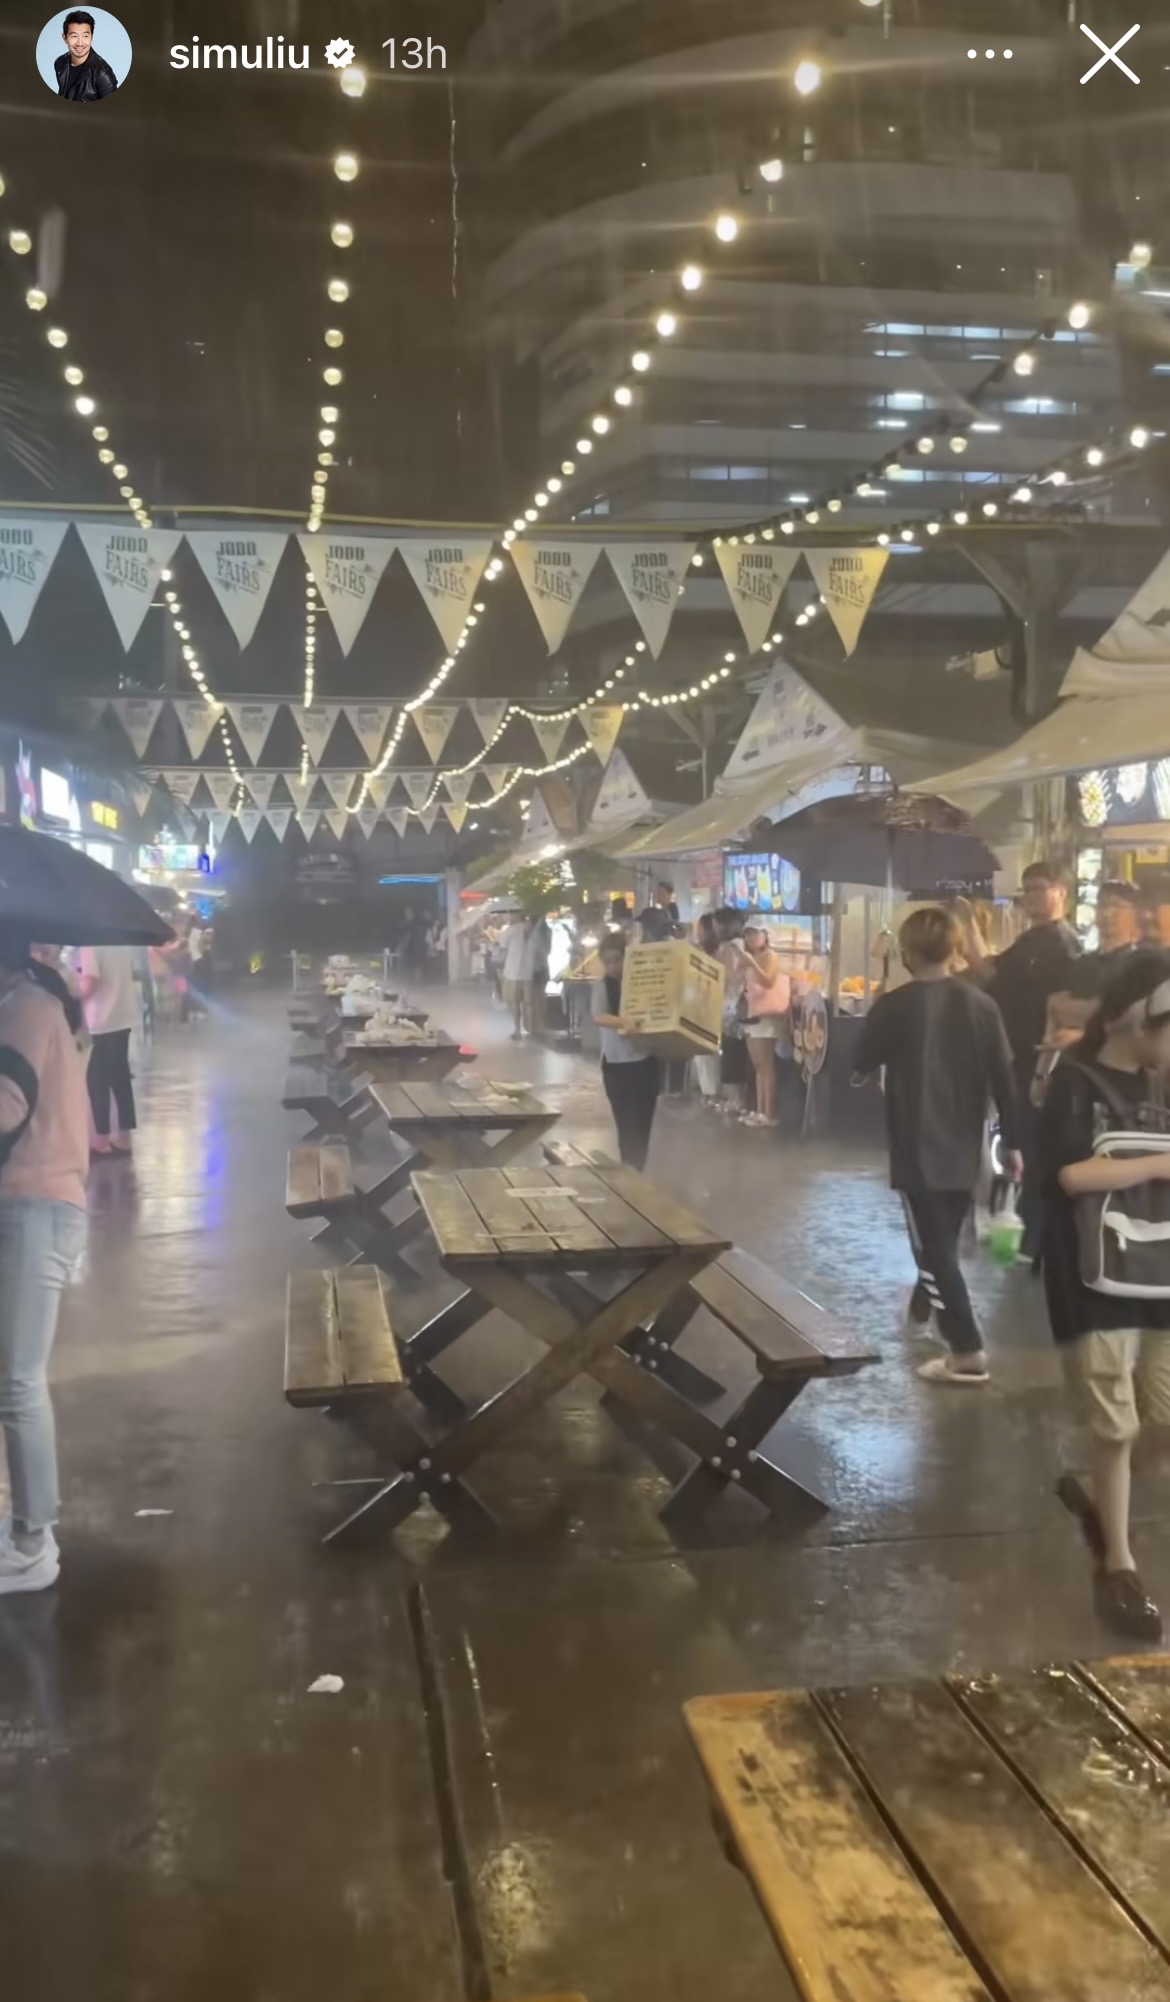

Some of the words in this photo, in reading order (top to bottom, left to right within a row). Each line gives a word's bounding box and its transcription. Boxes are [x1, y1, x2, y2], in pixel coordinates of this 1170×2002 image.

[105, 551, 148, 589] FAIRS
[217, 556, 260, 591] FAIRS
[325, 560, 365, 595] FAIRS
[426, 559, 466, 596] FAIRS
[534, 564, 572, 600] FAIRS
[632, 569, 670, 600] FAIRS
[737, 570, 773, 602] FAIRS
